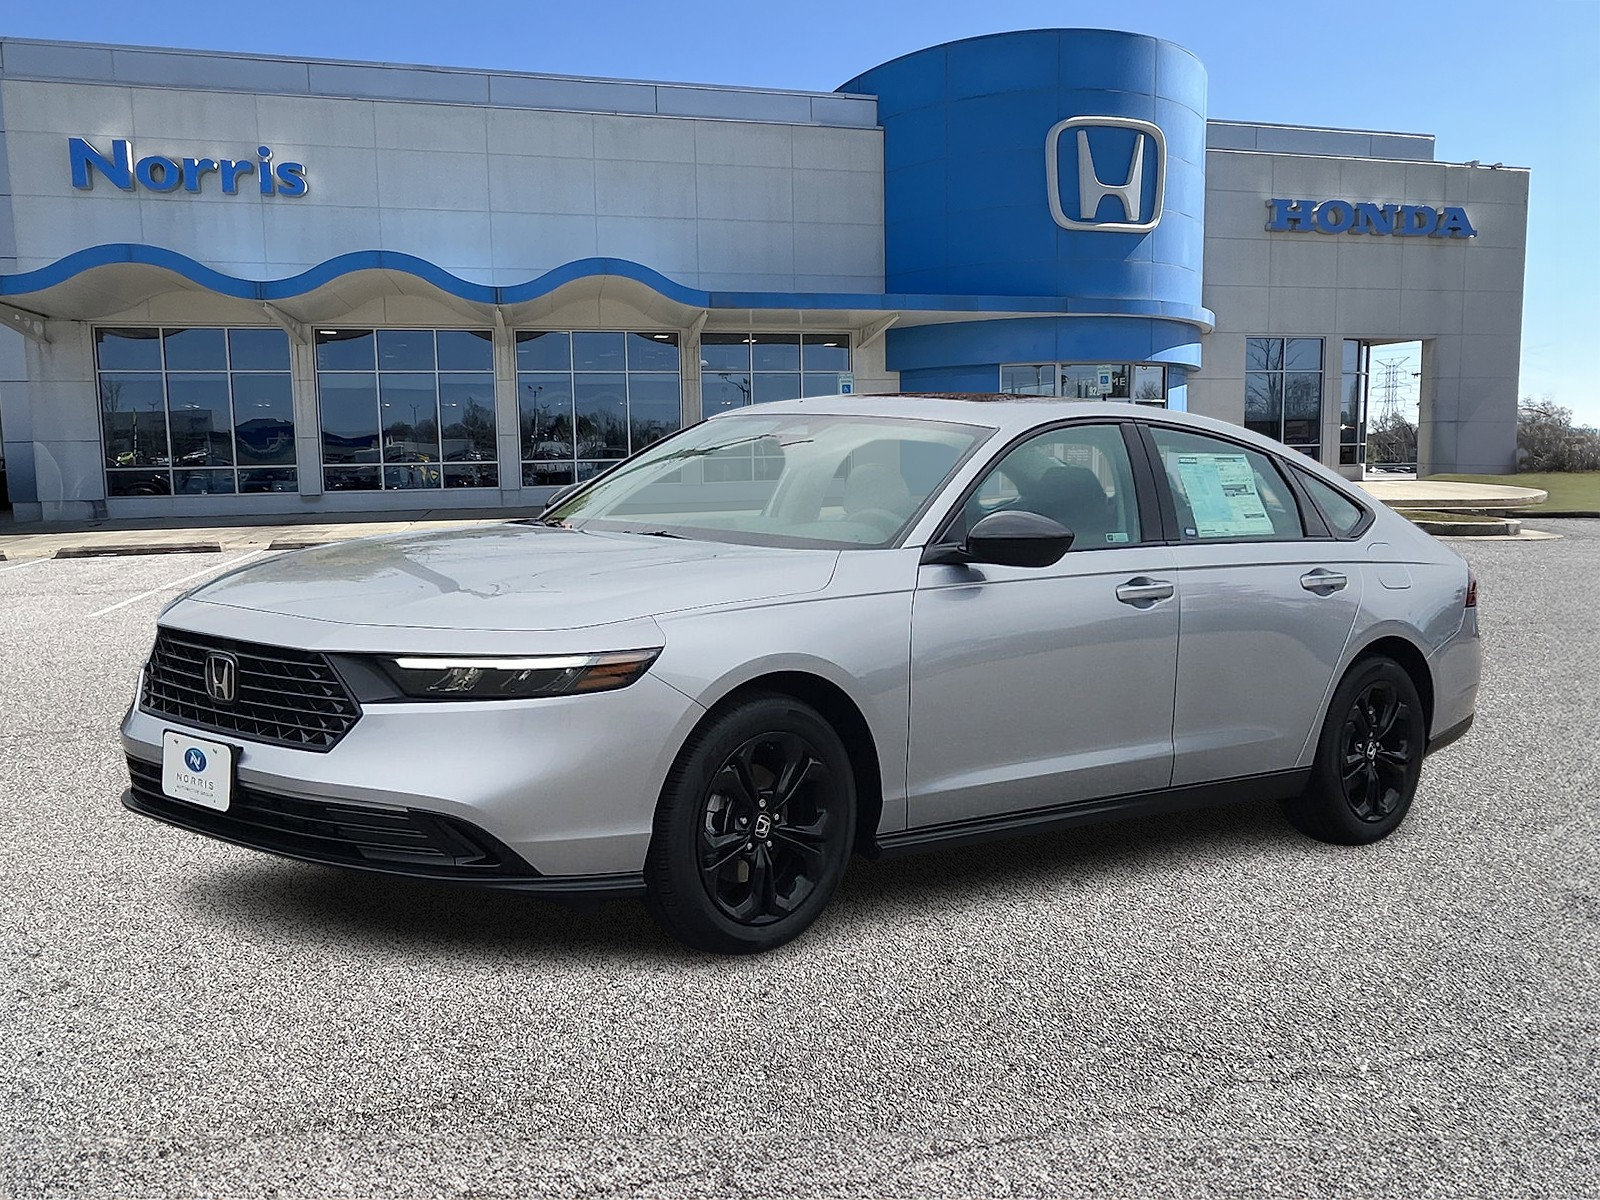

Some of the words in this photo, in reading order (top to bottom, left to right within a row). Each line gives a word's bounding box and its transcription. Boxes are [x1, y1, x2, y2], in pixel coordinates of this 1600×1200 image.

[68, 137, 309, 197] Norris
[1266, 198, 1478, 239] HONDA
[176, 772, 214, 790] NORRIS
